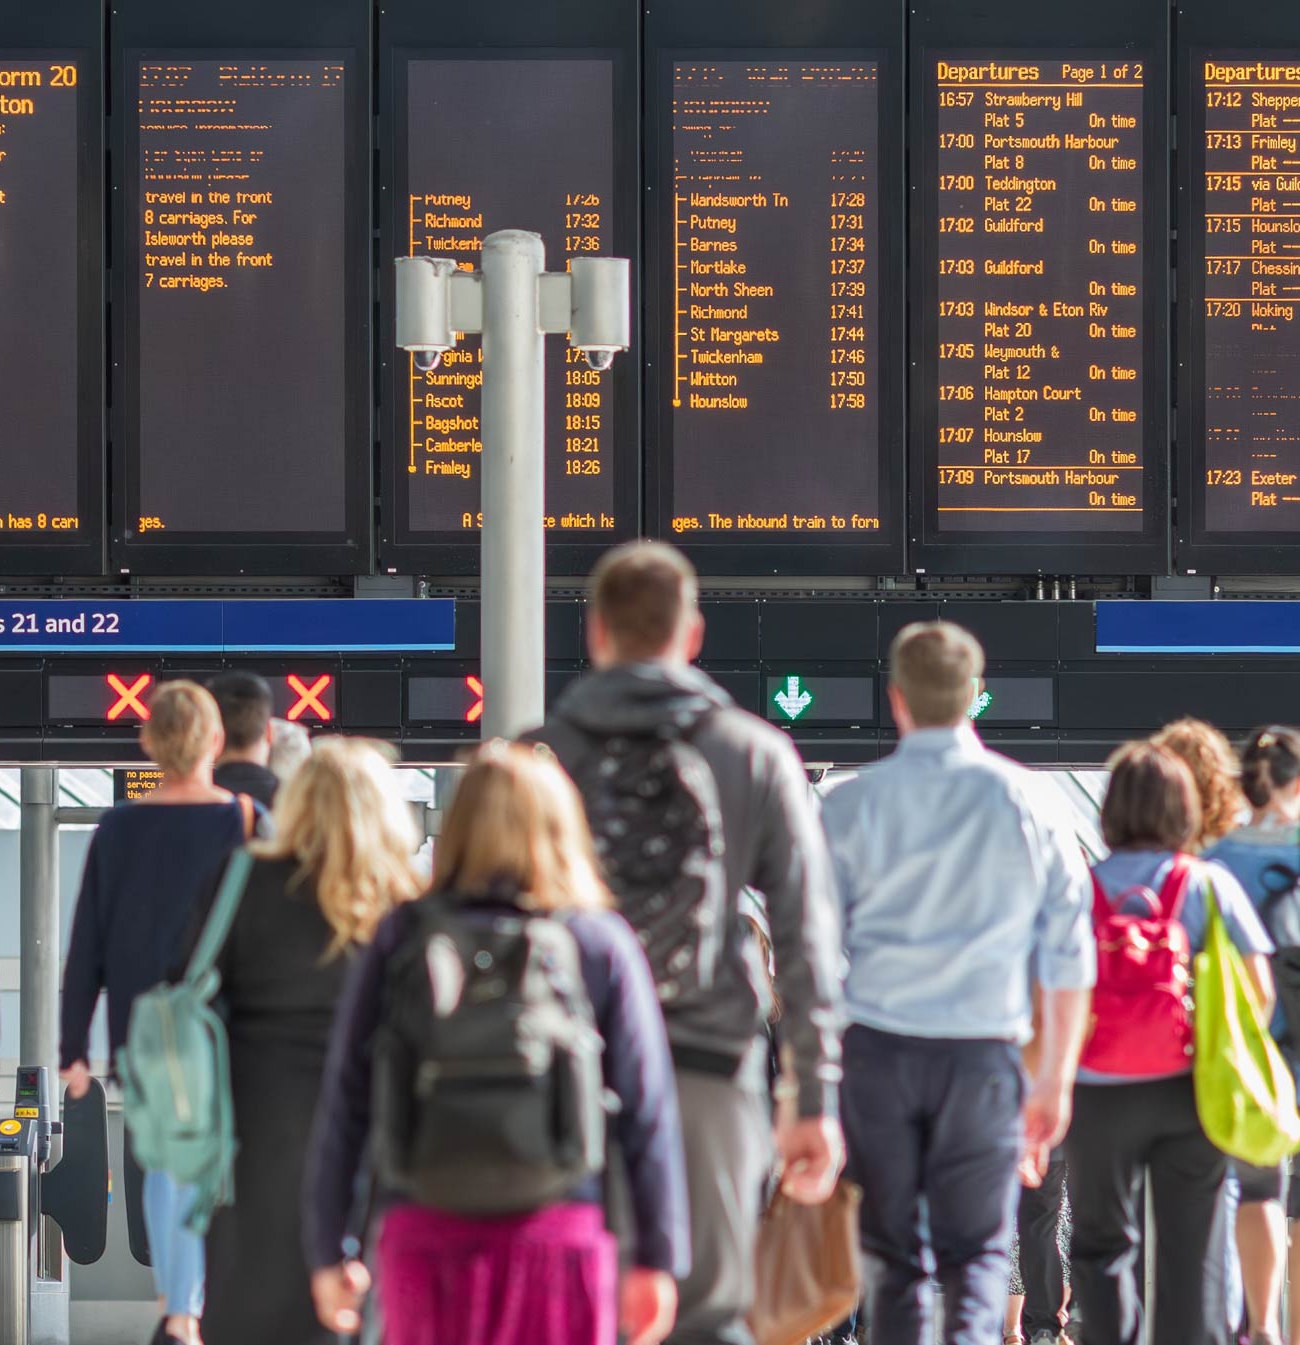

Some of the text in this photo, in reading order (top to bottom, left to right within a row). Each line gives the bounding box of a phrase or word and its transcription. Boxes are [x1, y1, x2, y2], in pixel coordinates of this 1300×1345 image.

[50, 66, 76, 86] 20
[938, 63, 1039, 82] Departures
[1063, 64, 1142, 82] Page 1 of 2
[1205, 63, 1300, 83] Departures
[940, 92, 1082, 110] 16:57 Strawberry Hill
[1208, 92, 1241, 107] 17:12
[985, 113, 1136, 128] Plat 5 On time
[940, 134, 1118, 149] 17:00 Portsmouth Harbour
[1208, 134, 1296, 152] 17:13 Frimley
[940, 176, 1056, 194] 17:00 Teddington
[1207, 176, 1241, 191] 17:15
[985, 197, 1136, 211] Plat 22 On time
[145, 210, 256, 228] 8 carriages. For
[426, 213, 599, 228] Richmond 17:32
[940, 218, 1043, 232] 17:02 Guildford
[1207, 218, 1240, 232] 17:15
[145, 231, 253, 249] Isleworth please
[691, 237, 864, 251] Barnes 17:34
[146, 252, 272, 266] travel in the front
[691, 259, 865, 274] Mortlake 17:37
[691, 282, 864, 296] North Sheen 17:39
[691, 305, 862, 319] Richmond 17:41
[940, 302, 1107, 316] 17:03 Windsor & Eton Riv
[1207, 302, 1292, 320] 17:20 Woking
[691, 327, 864, 345] St Margarets 17:44
[940, 344, 1059, 361] 17:05 Weymouth &
[691, 371, 864, 386] Whitton 17:50
[426, 393, 600, 407] Ascot 18:09
[940, 386, 1081, 404] 17:06 Hampton Court
[426, 415, 600, 433] Bagshot 18:15
[940, 428, 1042, 442] 17:07 Hounslow
[985, 449, 1136, 463] Plat 17 On time
[426, 460, 600, 478] Frimley 18:26
[1208, 470, 1296, 485] 17:23 Exeter
[9, 514, 32, 528] has
[38, 514, 46, 528] 8
[709, 514, 845, 528] The inbound train to
[12, 613, 39, 633] 21
[46, 613, 84, 633] and
[92, 613, 119, 633] 22
[127, 780, 156, 789] service
[127, 790, 142, 799] this
